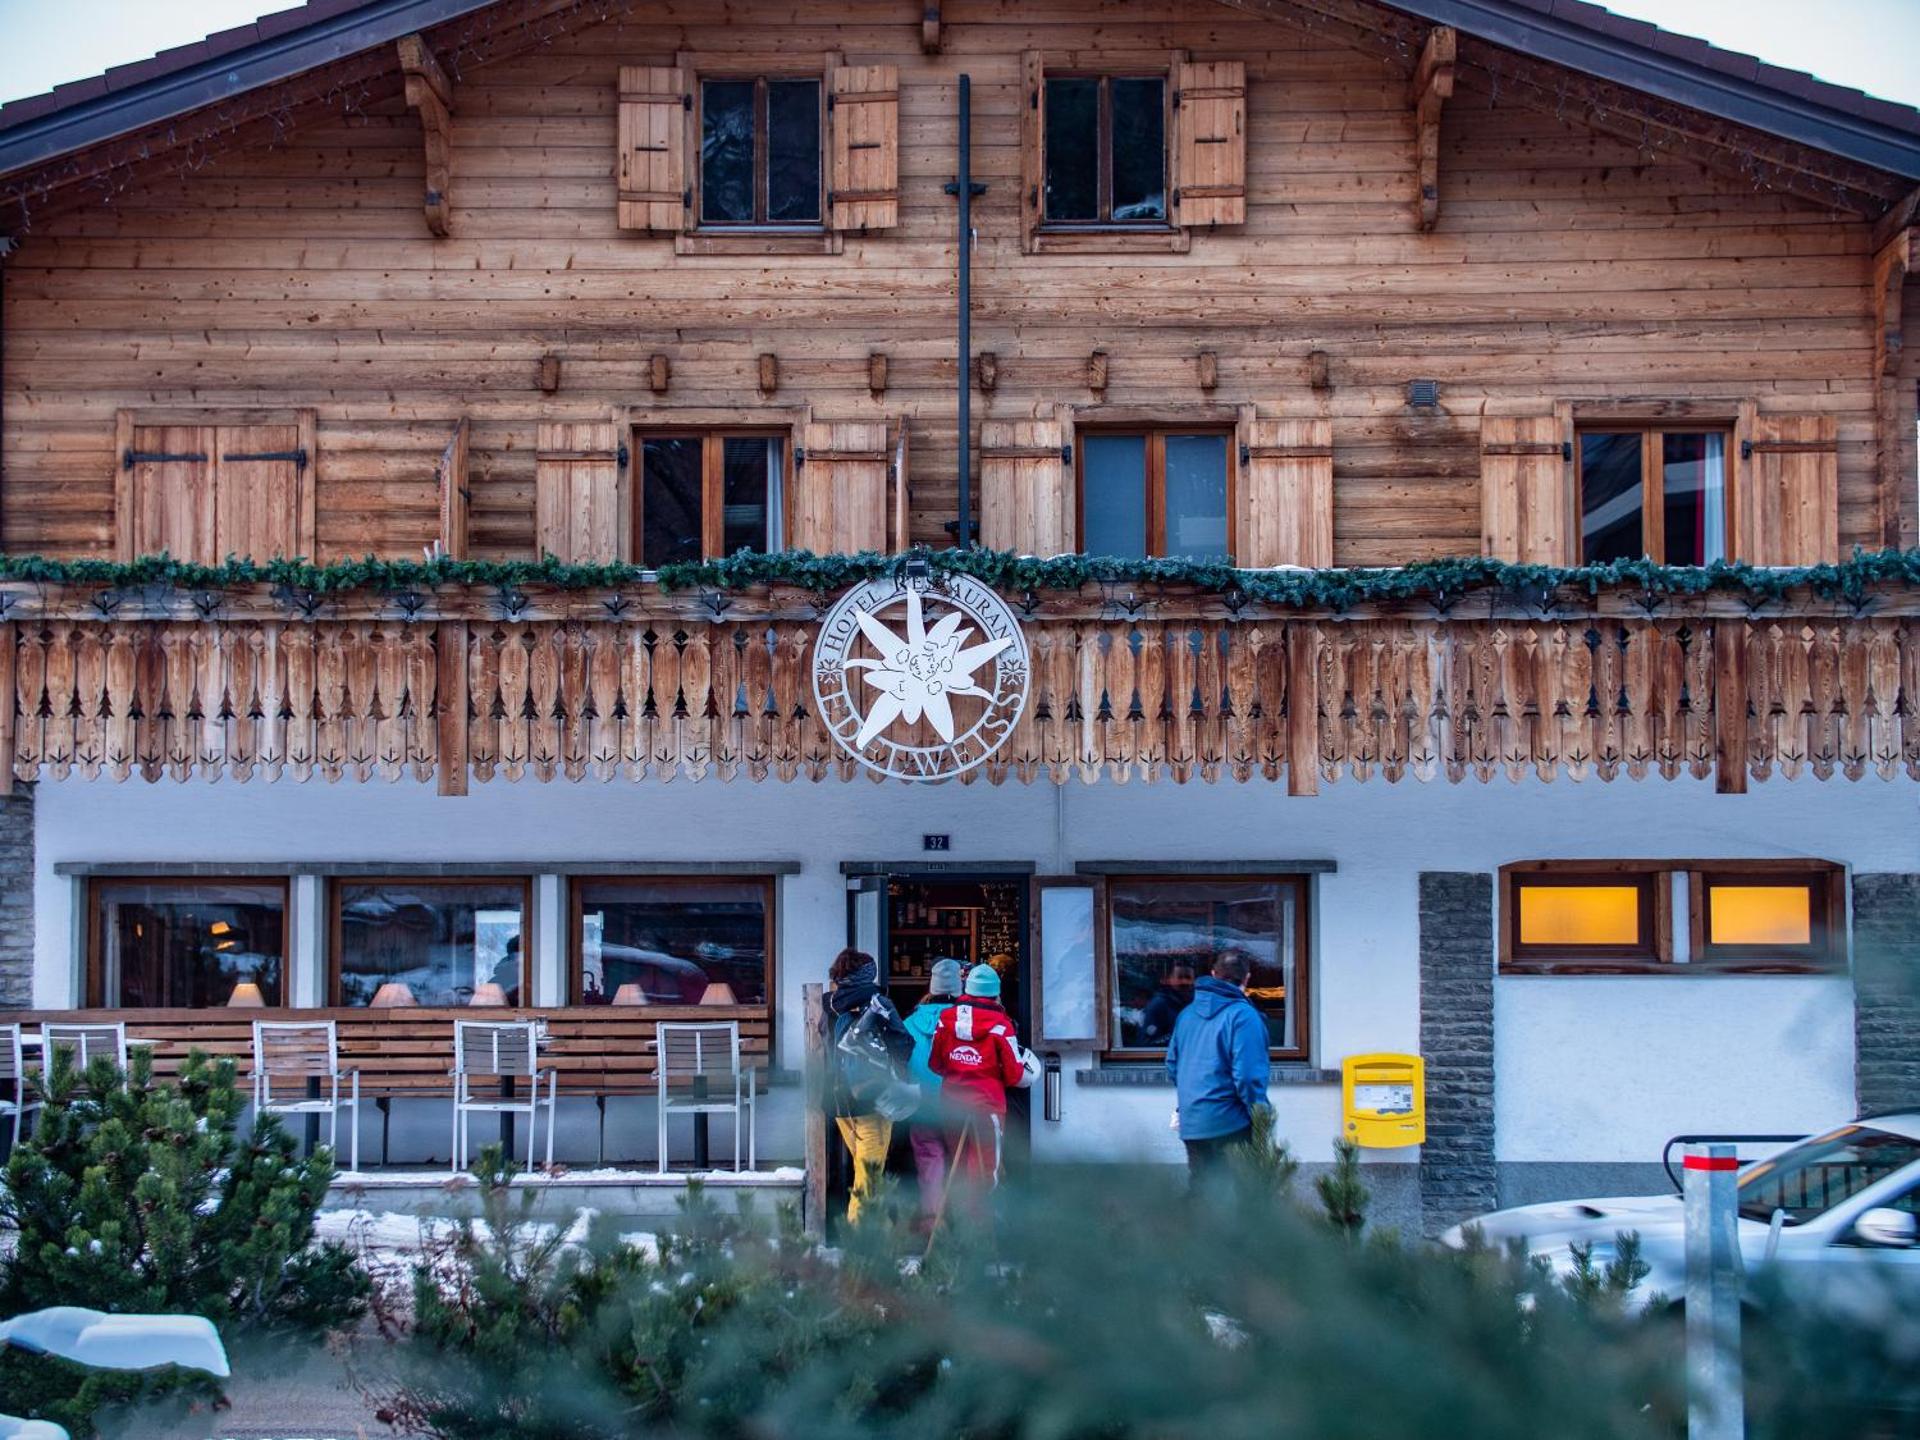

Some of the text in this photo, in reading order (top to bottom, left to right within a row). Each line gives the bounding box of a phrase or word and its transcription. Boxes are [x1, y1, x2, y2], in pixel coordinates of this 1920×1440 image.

[825, 573, 1017, 659] HOTEL RESAURANT
[818, 688, 1022, 778] EDELWEISS
[930, 836, 943, 849] 32
[949, 1052, 982, 1063] NENDAZ
